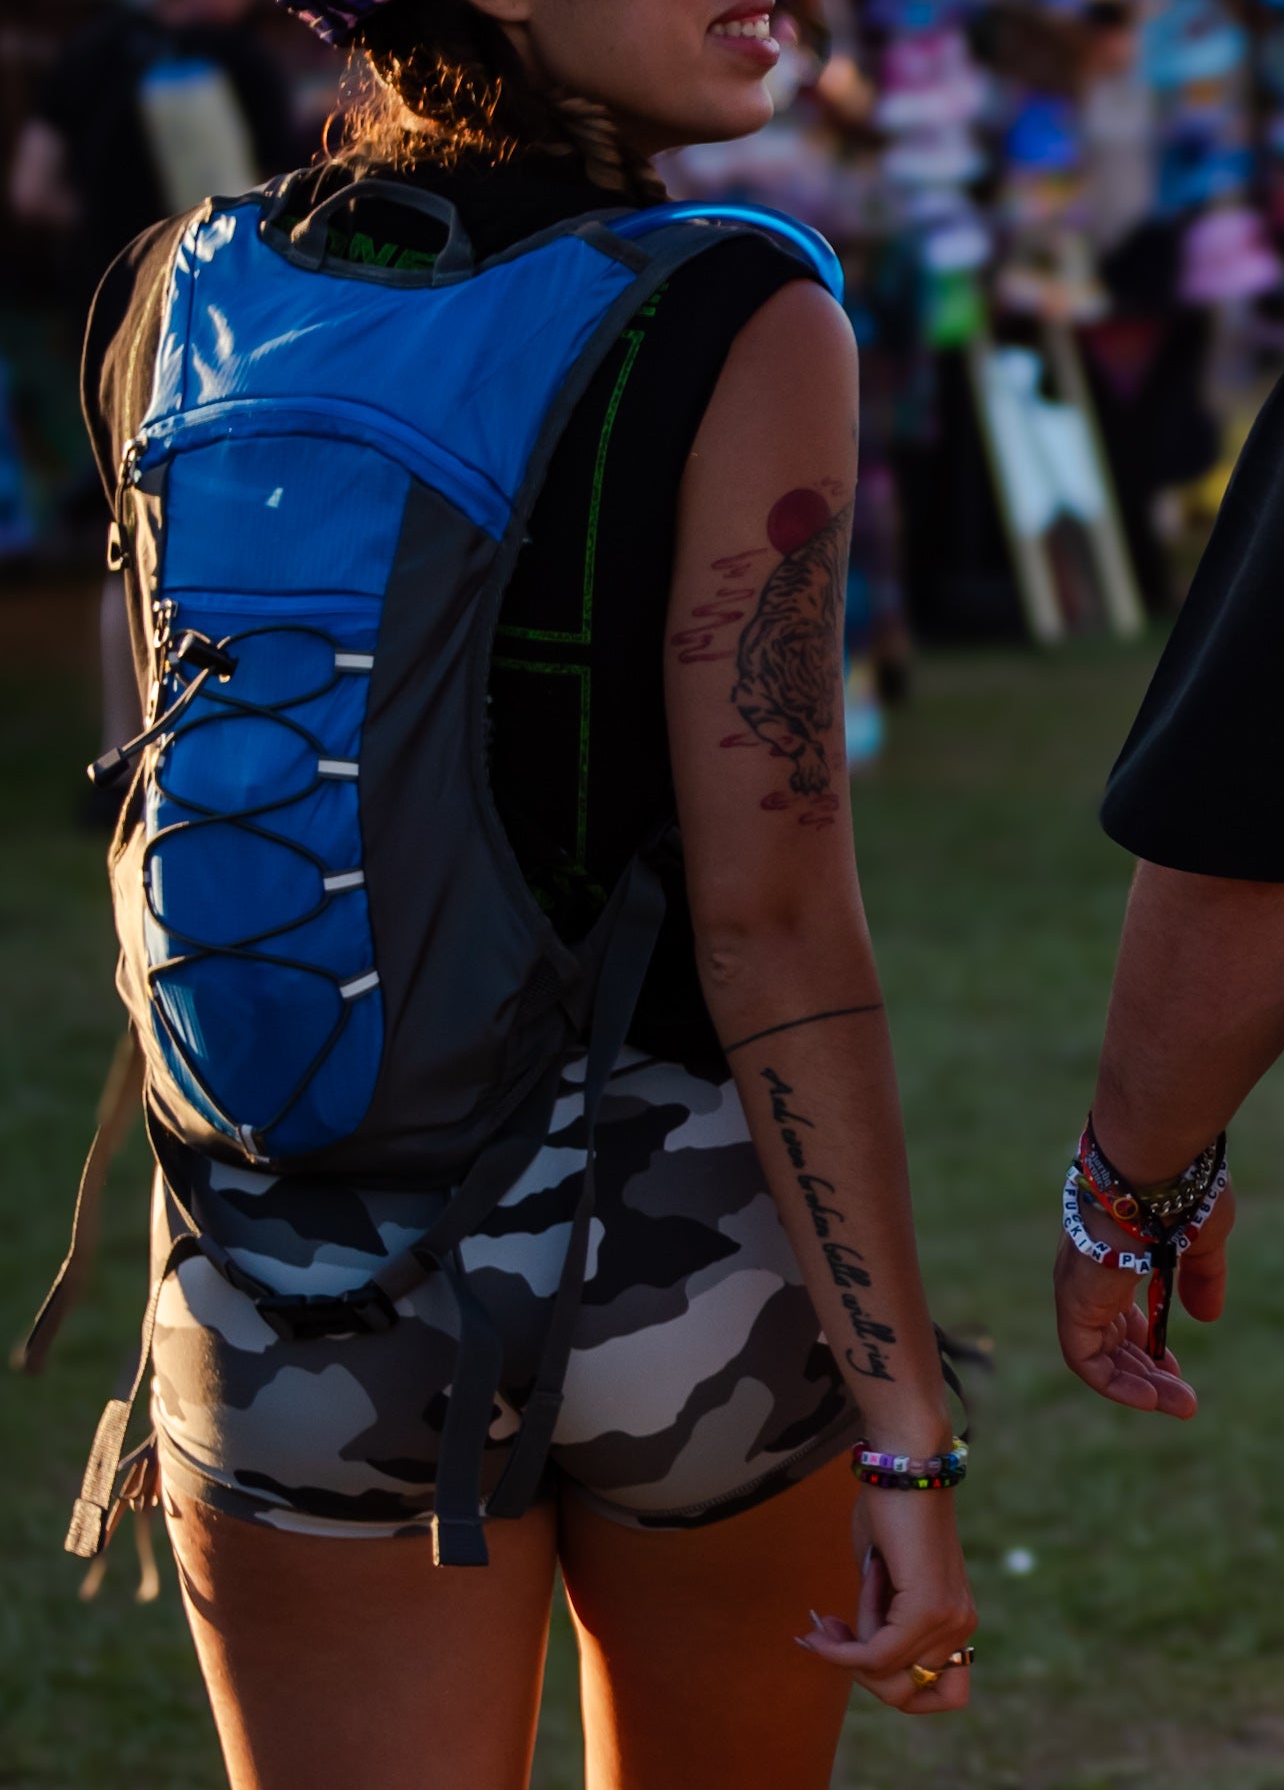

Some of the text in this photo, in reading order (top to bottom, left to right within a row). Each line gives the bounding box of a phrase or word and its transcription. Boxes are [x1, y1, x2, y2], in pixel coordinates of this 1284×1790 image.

[760, 1067, 814, 1128] And
[796, 1173, 846, 1239] broken
[821, 1240, 873, 1292] bells
[839, 1291, 896, 1347] will
[845, 1333, 896, 1383] ring
